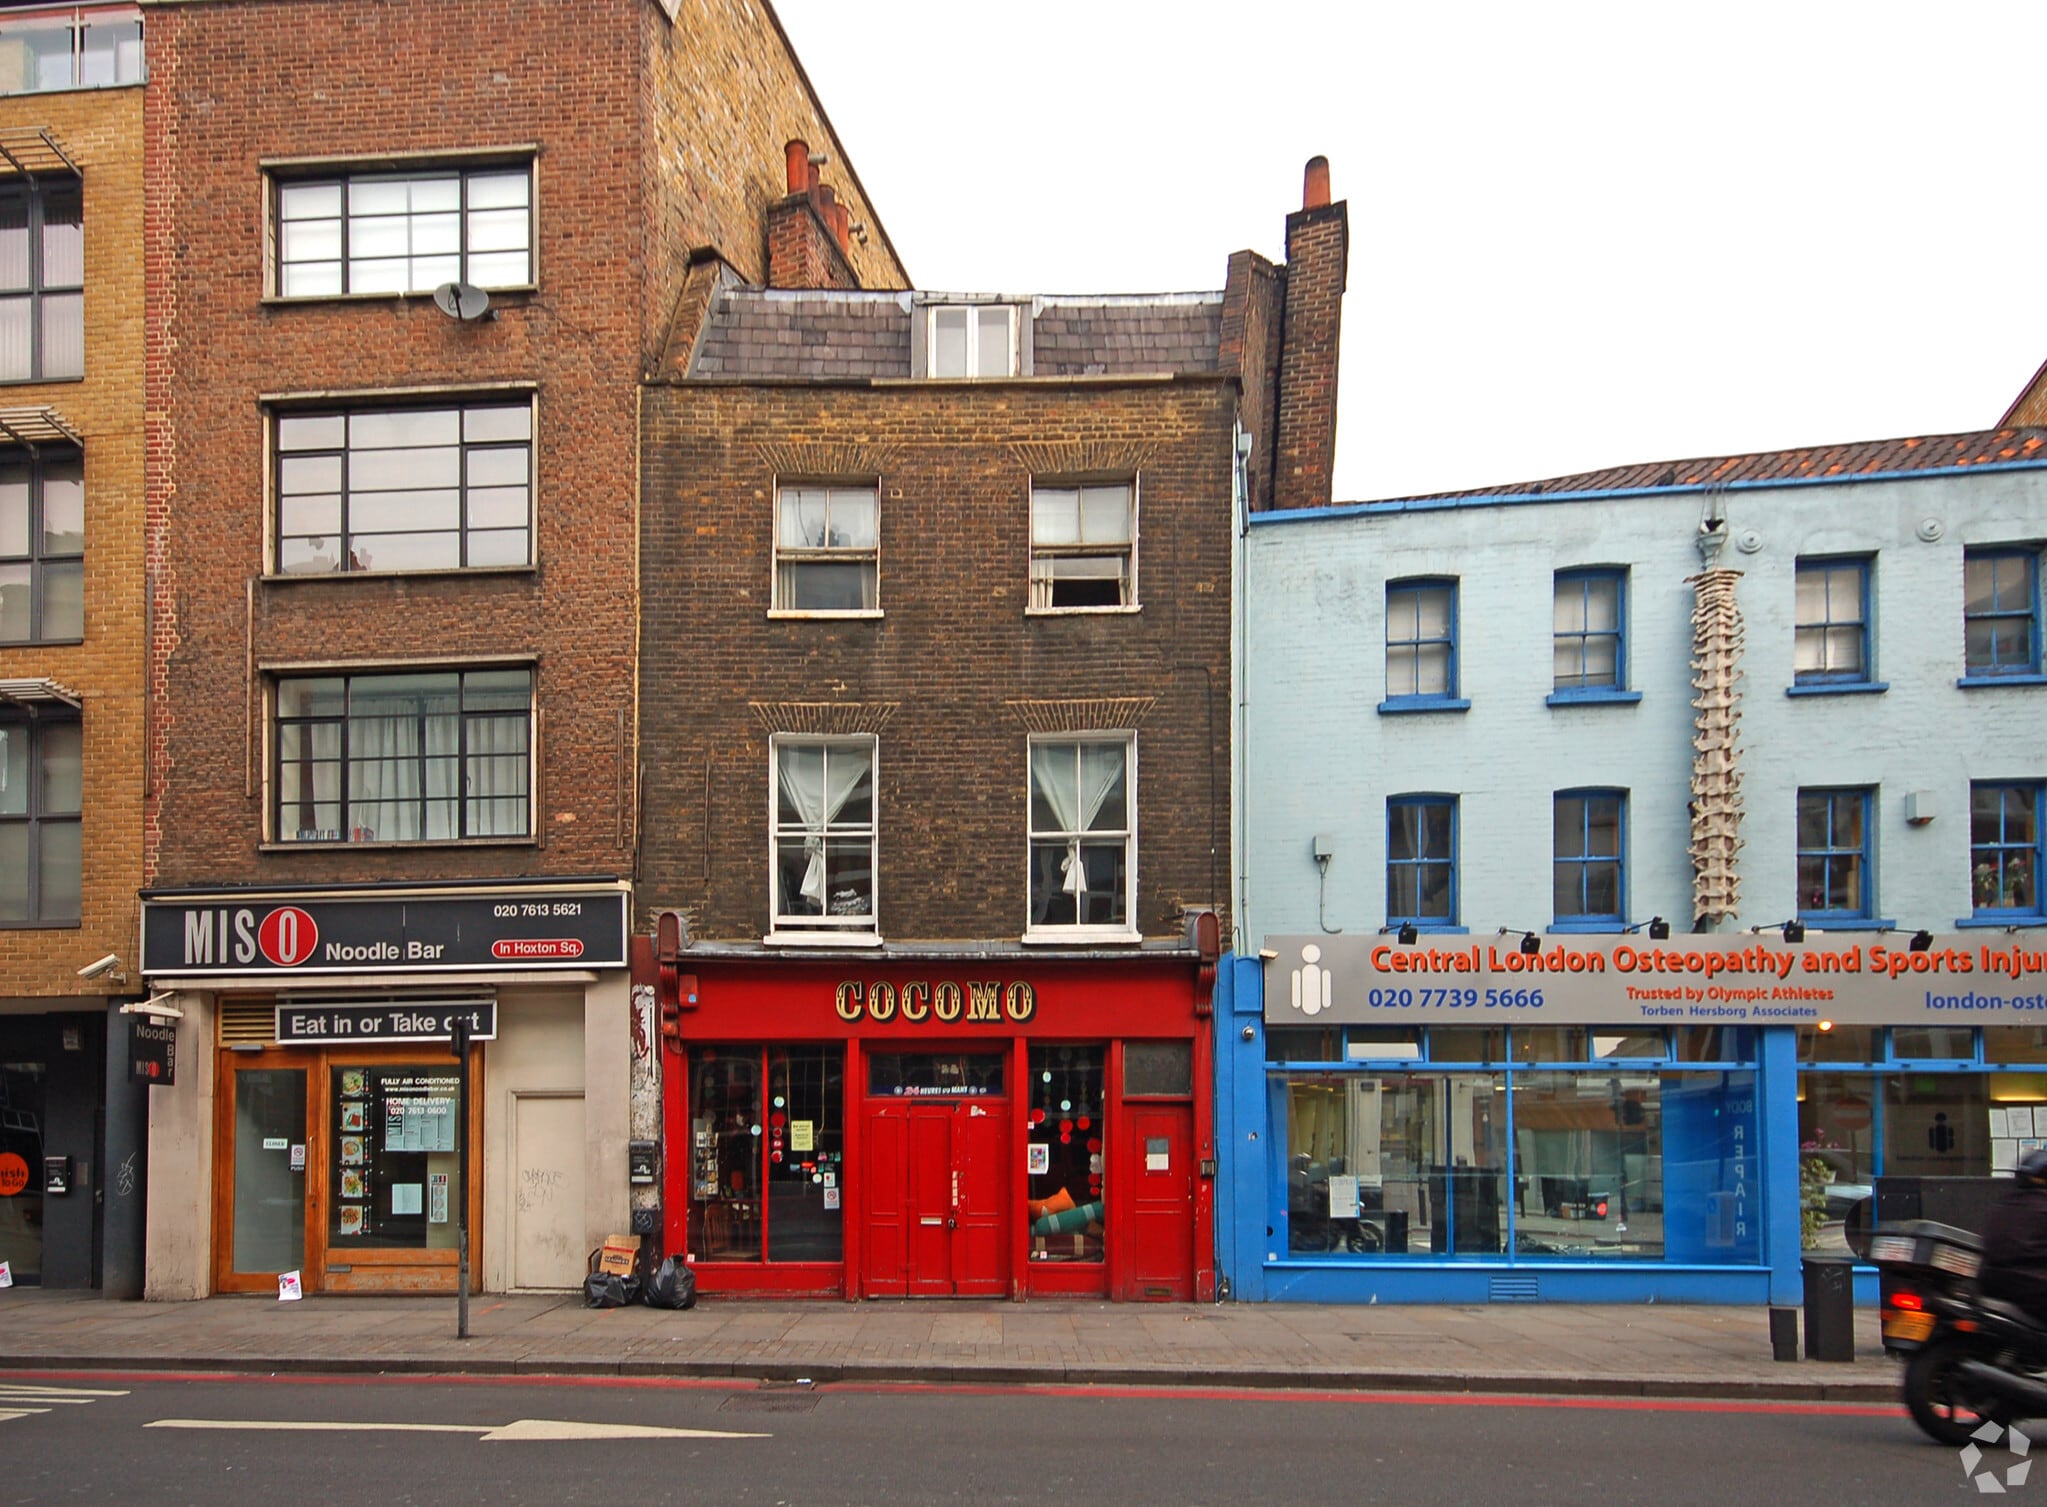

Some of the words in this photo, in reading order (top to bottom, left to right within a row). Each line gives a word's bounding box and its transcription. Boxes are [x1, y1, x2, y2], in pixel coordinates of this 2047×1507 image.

[493, 904, 518, 918] 020
[521, 903, 549, 917] 7613
[552, 902, 582, 916] 5621
[184, 908, 299, 965] MISO
[325, 941, 400, 961] Noodle
[407, 941, 445, 960] Bar
[500, 942, 511, 955] In
[514, 941, 557, 955] Hoxton
[559, 940, 580, 956] Sq.
[1370, 944, 1482, 973] Central
[1487, 944, 1606, 973] London
[1612, 943, 1795, 979] Osteopathy
[1801, 944, 1861, 973] and
[1869, 944, 1974, 979] Sports
[835, 980, 1036, 1022] COCOMO
[1368, 988, 1413, 1008] 020
[1418, 988, 1478, 1008] 7739
[1484, 988, 1545, 1008] 5666
[1626, 986, 1684, 1000] Trusted
[1685, 986, 1704, 1002] by
[1707, 986, 1768, 1003] Olympic
[1771, 986, 1834, 1001] Athletes
[1925, 991, 2047, 1011] london-ost
[1640, 1005, 1684, 1017] Torben
[1689, 1005, 1747, 1018] Hersborg
[1752, 1005, 1818, 1017] Associates
[136, 1024, 175, 1042] Noodle
[291, 1015, 327, 1034] Eat
[333, 1014, 352, 1034] in
[360, 1015, 382, 1033] or
[389, 1013, 436, 1032] Take
[443, 1012, 480, 1031] ot
[413, 1097, 451, 1106] DELIVERY
